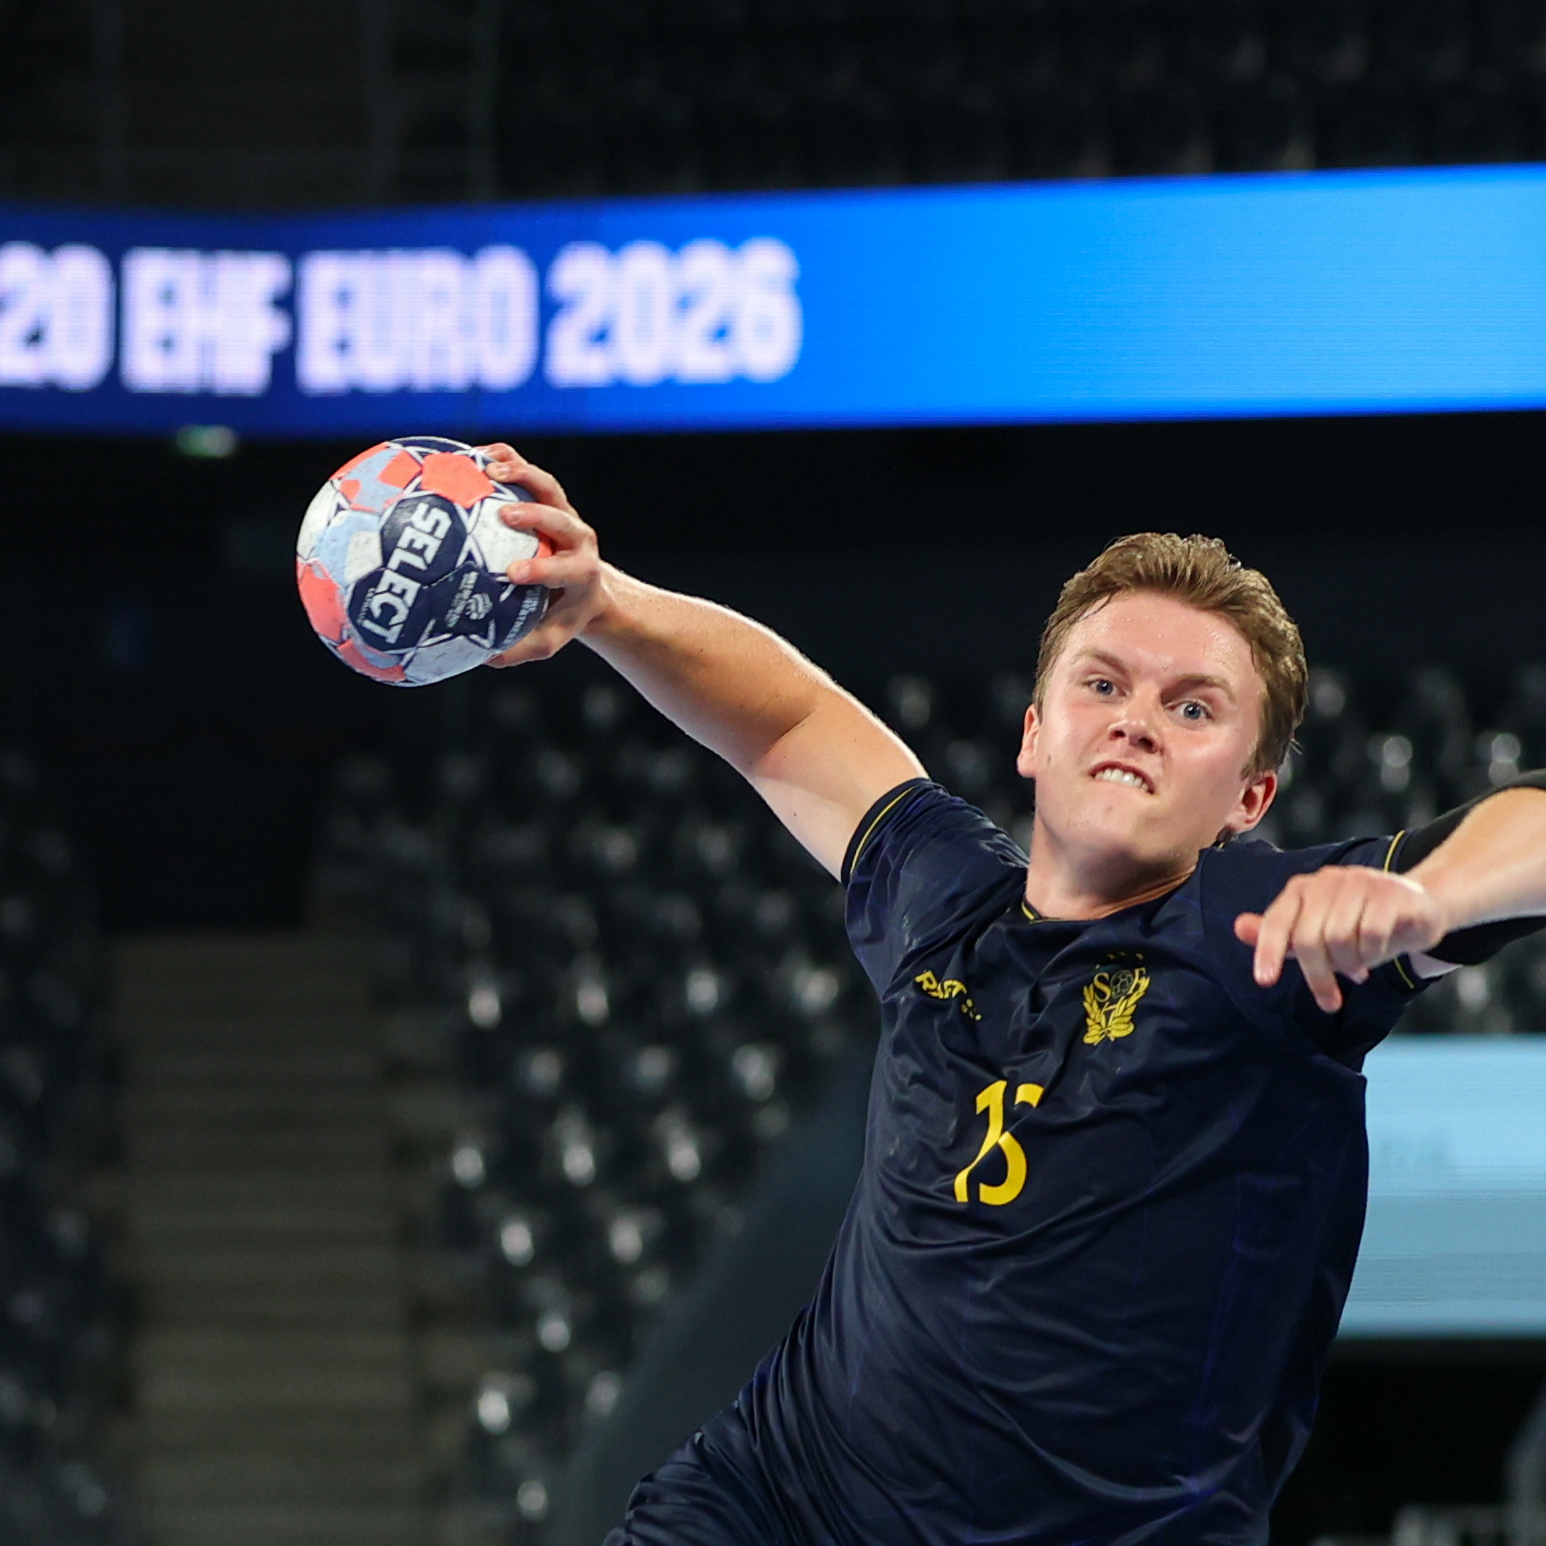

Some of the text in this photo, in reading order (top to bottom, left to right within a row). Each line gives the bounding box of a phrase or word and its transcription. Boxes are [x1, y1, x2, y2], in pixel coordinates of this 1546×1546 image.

[120, 246, 291, 396] EHF
[295, 243, 541, 398] EURO
[544, 236, 803, 389] 2026
[360, 501, 452, 646] SELECT
